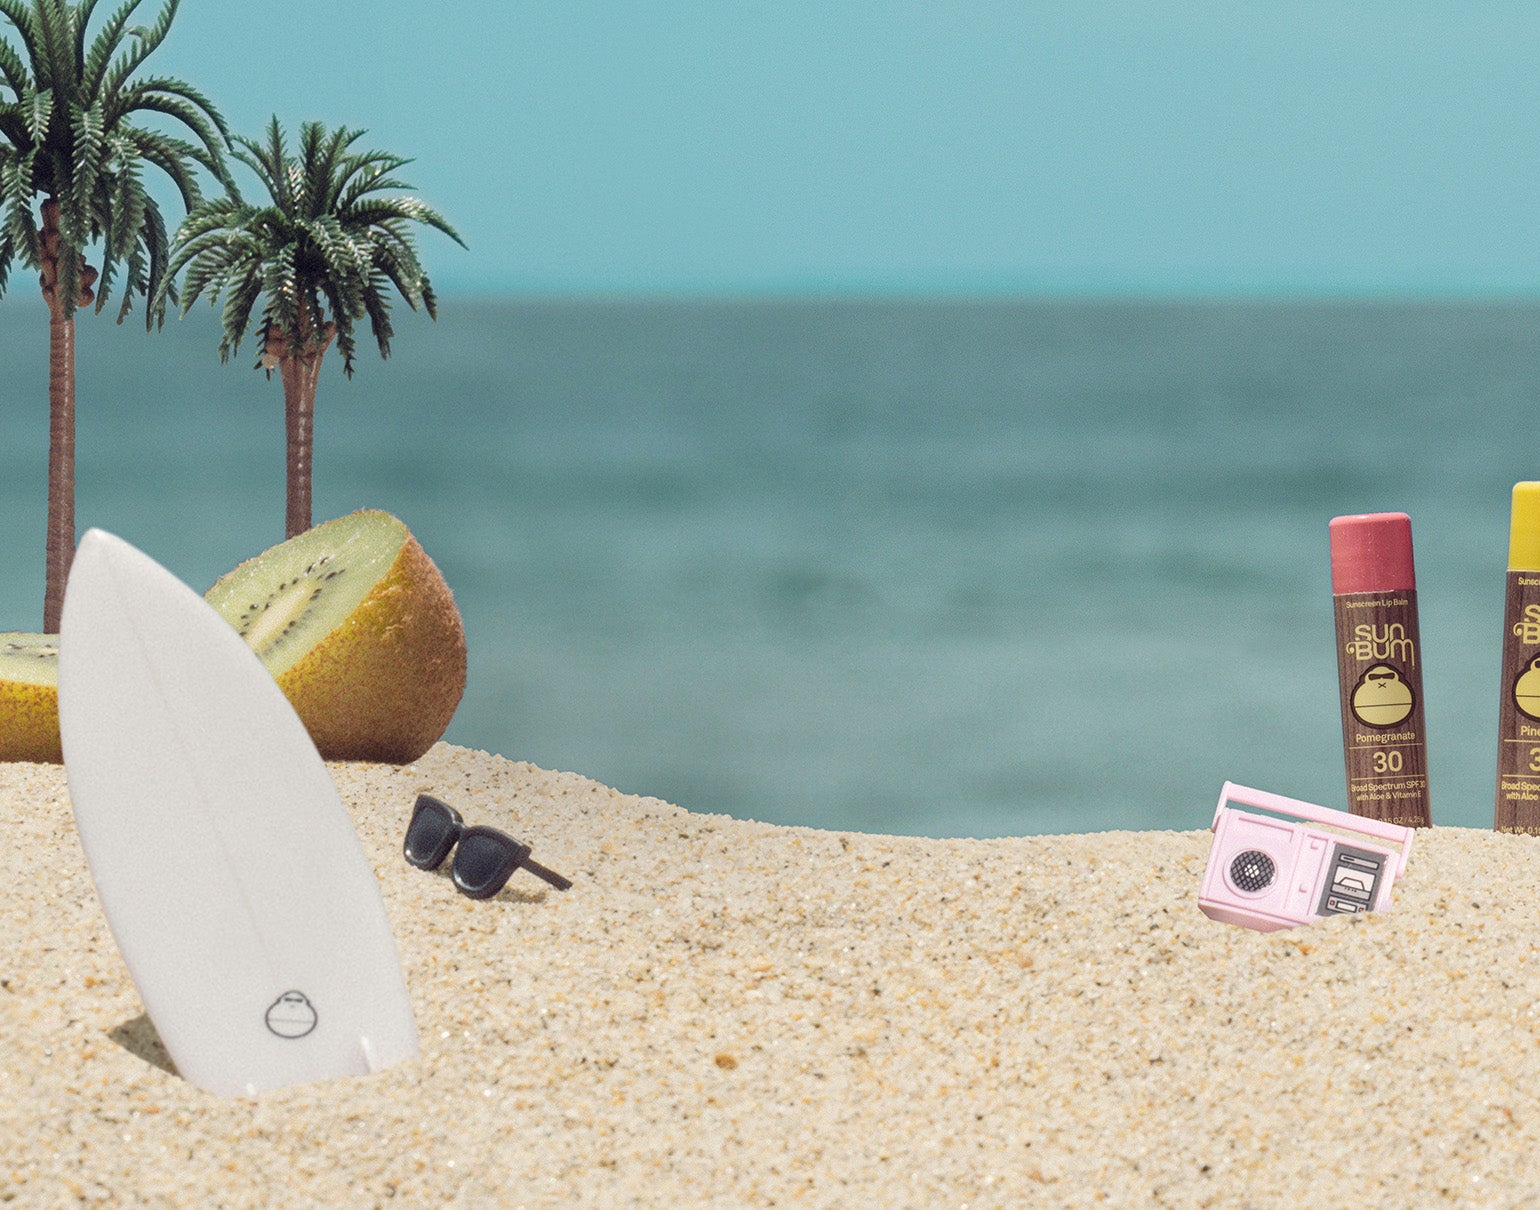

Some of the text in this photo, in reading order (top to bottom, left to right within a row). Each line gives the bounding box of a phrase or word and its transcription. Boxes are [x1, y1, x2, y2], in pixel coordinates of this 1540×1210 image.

[1346, 598, 1408, 609] Sunscreen Lip Balm
[1355, 732, 1415, 744] Pomegranate
[1372, 750, 1403, 773] 30
[1351, 784, 1369, 792] Broad
[1369, 782, 1406, 793] Spectrum
[1501, 781, 1519, 790] Broad
[1356, 793, 1369, 801] with
[1369, 792, 1385, 800] Aloe
[1392, 791, 1418, 799] Vitamin
[1521, 792, 1538, 801] Aloe
